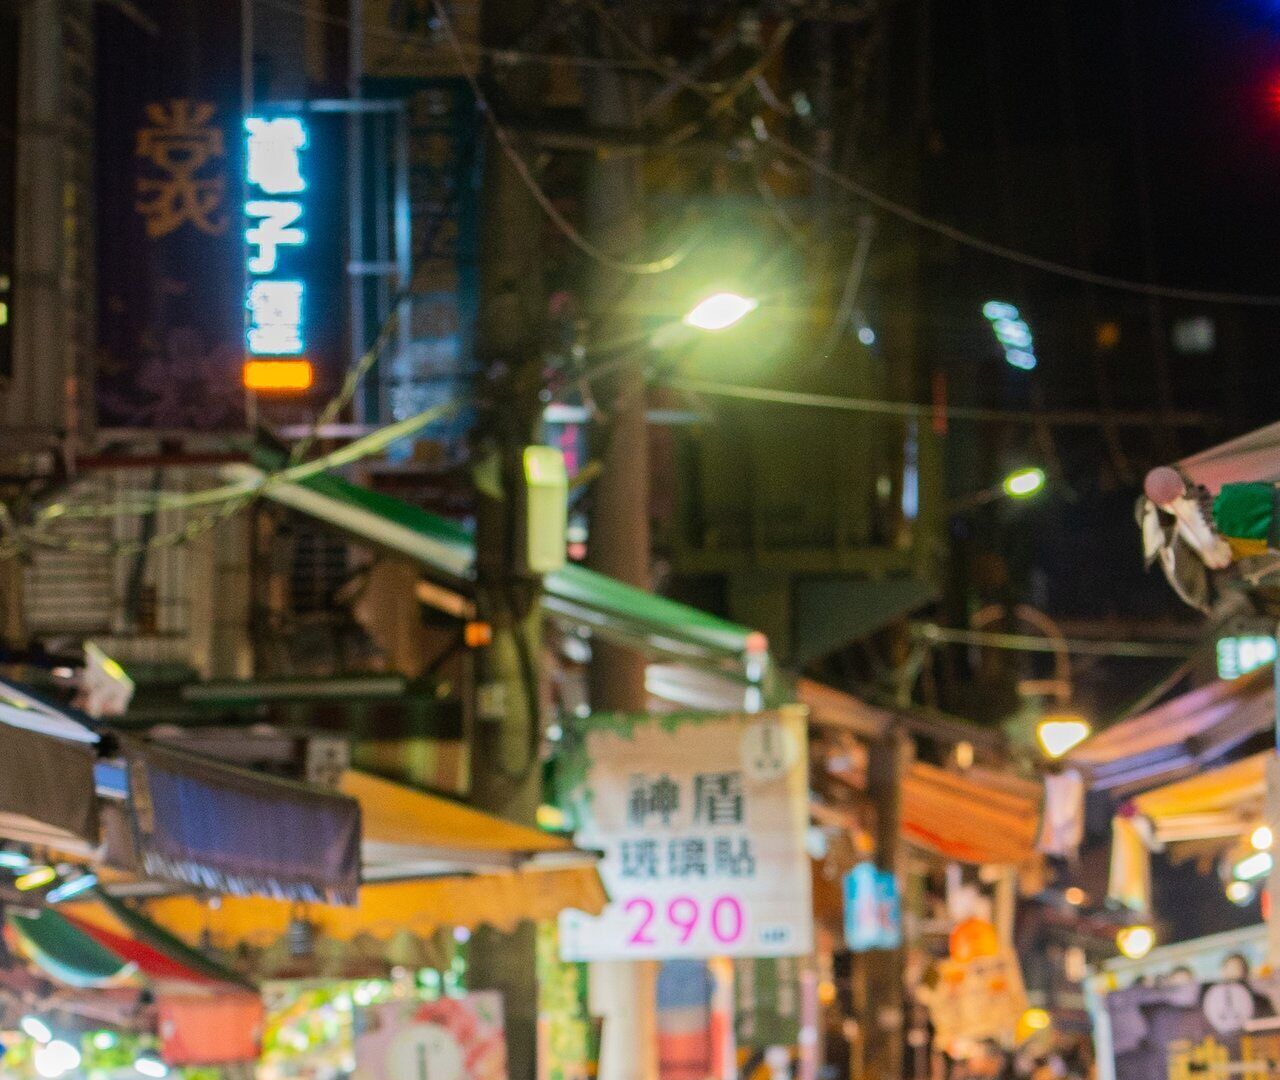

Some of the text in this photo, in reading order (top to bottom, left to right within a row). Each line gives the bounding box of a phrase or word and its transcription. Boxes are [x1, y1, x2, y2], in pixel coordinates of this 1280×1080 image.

[627, 772, 745, 828] 神盾
[621, 837, 756, 879] 玻璃貼
[623, 896, 744, 946] 290
